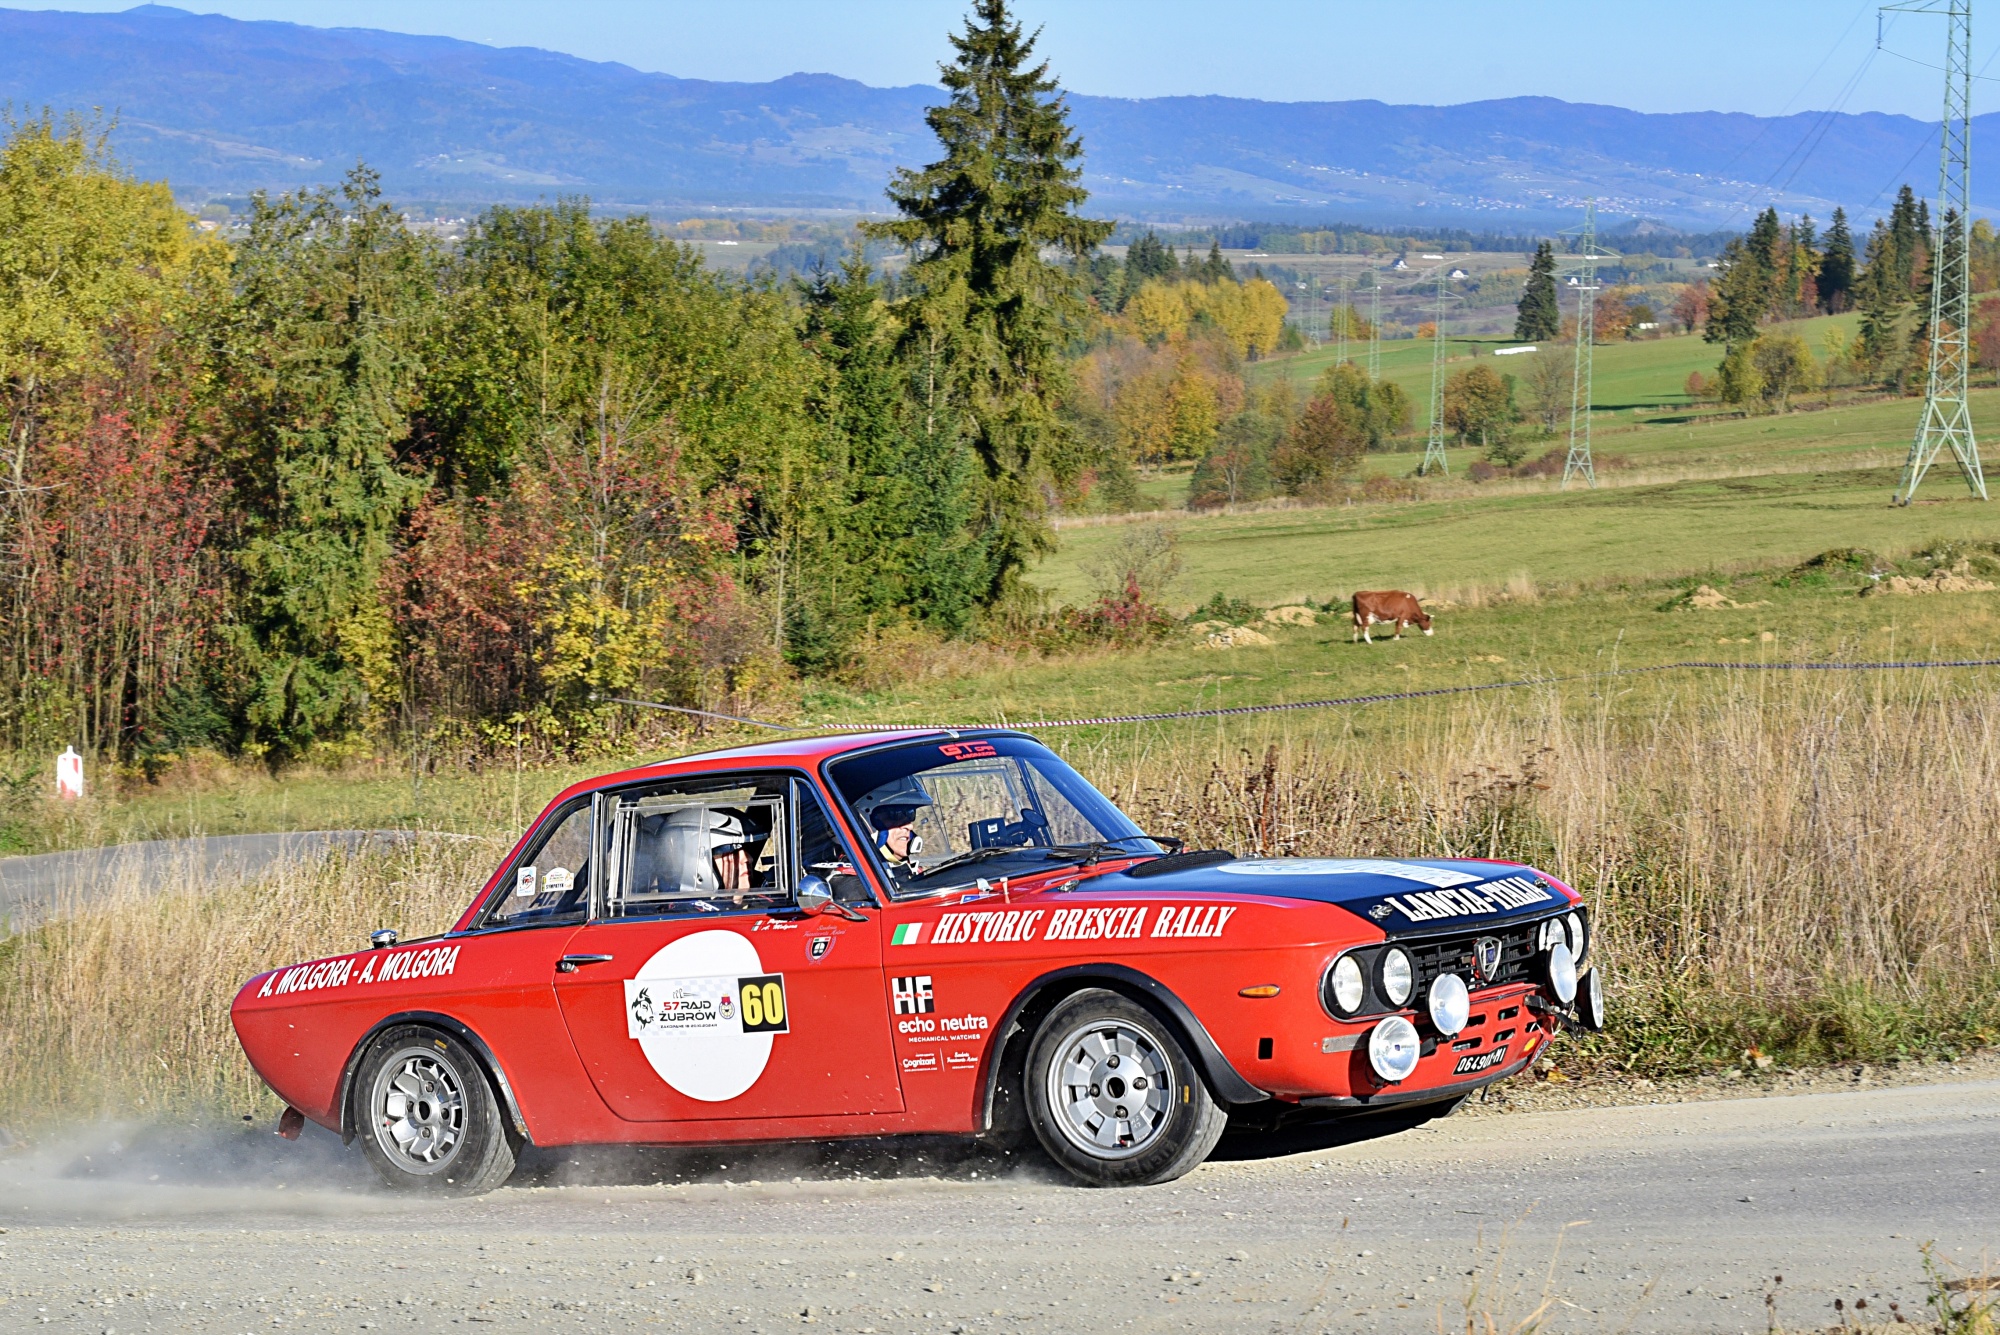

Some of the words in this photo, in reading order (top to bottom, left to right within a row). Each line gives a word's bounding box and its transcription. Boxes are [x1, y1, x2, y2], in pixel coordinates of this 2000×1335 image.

[938, 740, 988, 757] GT
[931, 910, 1044, 944] HISTORIC
[1044, 907, 1148, 940] BRESCIA
[1150, 907, 1236, 938] RALLY
[257, 972, 279, 998] A.
[275, 957, 356, 995] MOLGORA
[357, 955, 379, 984] A.
[377, 945, 461, 982] MOLGORA
[663, 1001, 679, 1010] 57
[680, 1000, 711, 1010] RAJD
[741, 982, 784, 1026] 60
[891, 976, 934, 1015] HF
[658, 1009, 717, 1022] ŻUBRÓW
[898, 1016, 935, 1033] echo
[940, 1013, 989, 1032] neutra
[908, 1035, 949, 1043] MECHANICAL
[950, 1033, 981, 1041] WATCHES
